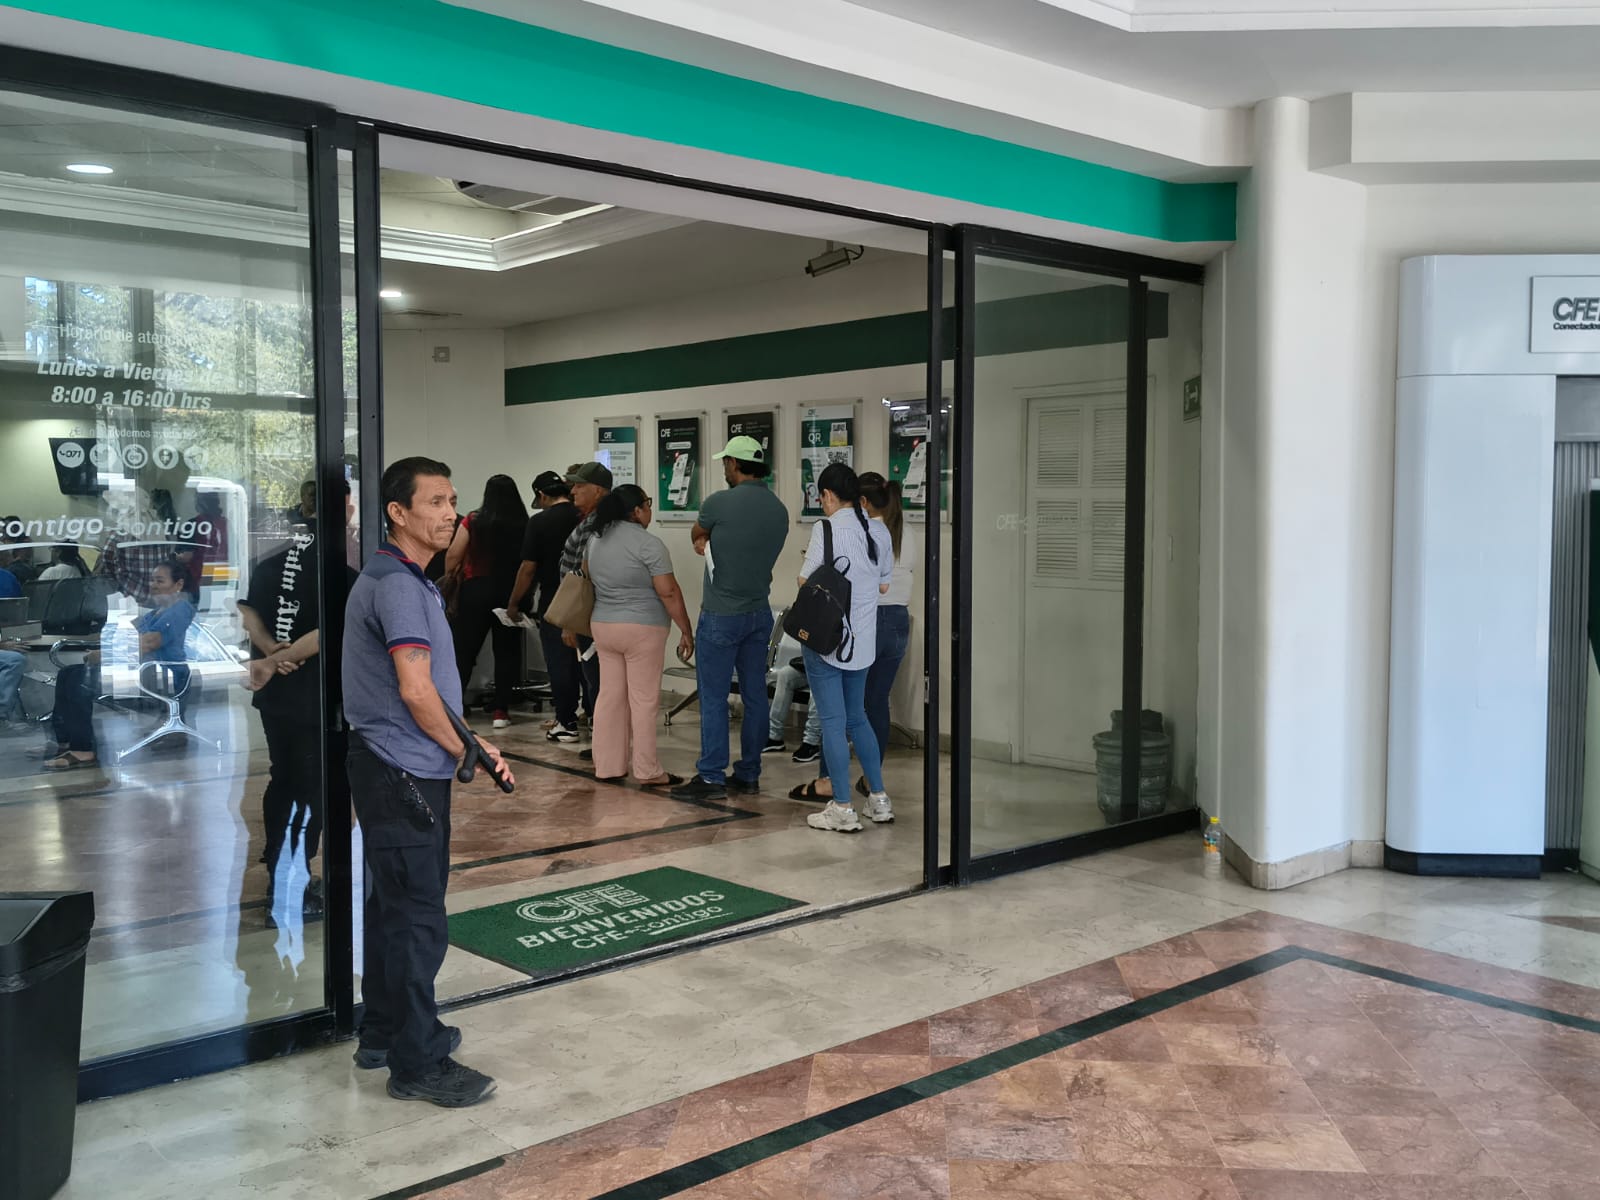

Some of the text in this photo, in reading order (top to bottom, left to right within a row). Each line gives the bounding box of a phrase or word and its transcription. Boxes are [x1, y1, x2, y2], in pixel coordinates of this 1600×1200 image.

[116, 328, 134, 343] de
[37, 360, 98, 378] Lunes
[103, 367, 115, 379] a
[123, 361, 195, 384] Viernes
[51, 386, 212, 410] 8:00 a 16:00 hrs
[808, 432, 822, 445] QR
[0, 515, 104, 540] ontigo
[116, 517, 213, 540] contigo
[280, 532, 315, 591] Palm
[516, 883, 649, 923] CFE
[516, 890, 725, 948] BIENVENIDOS
